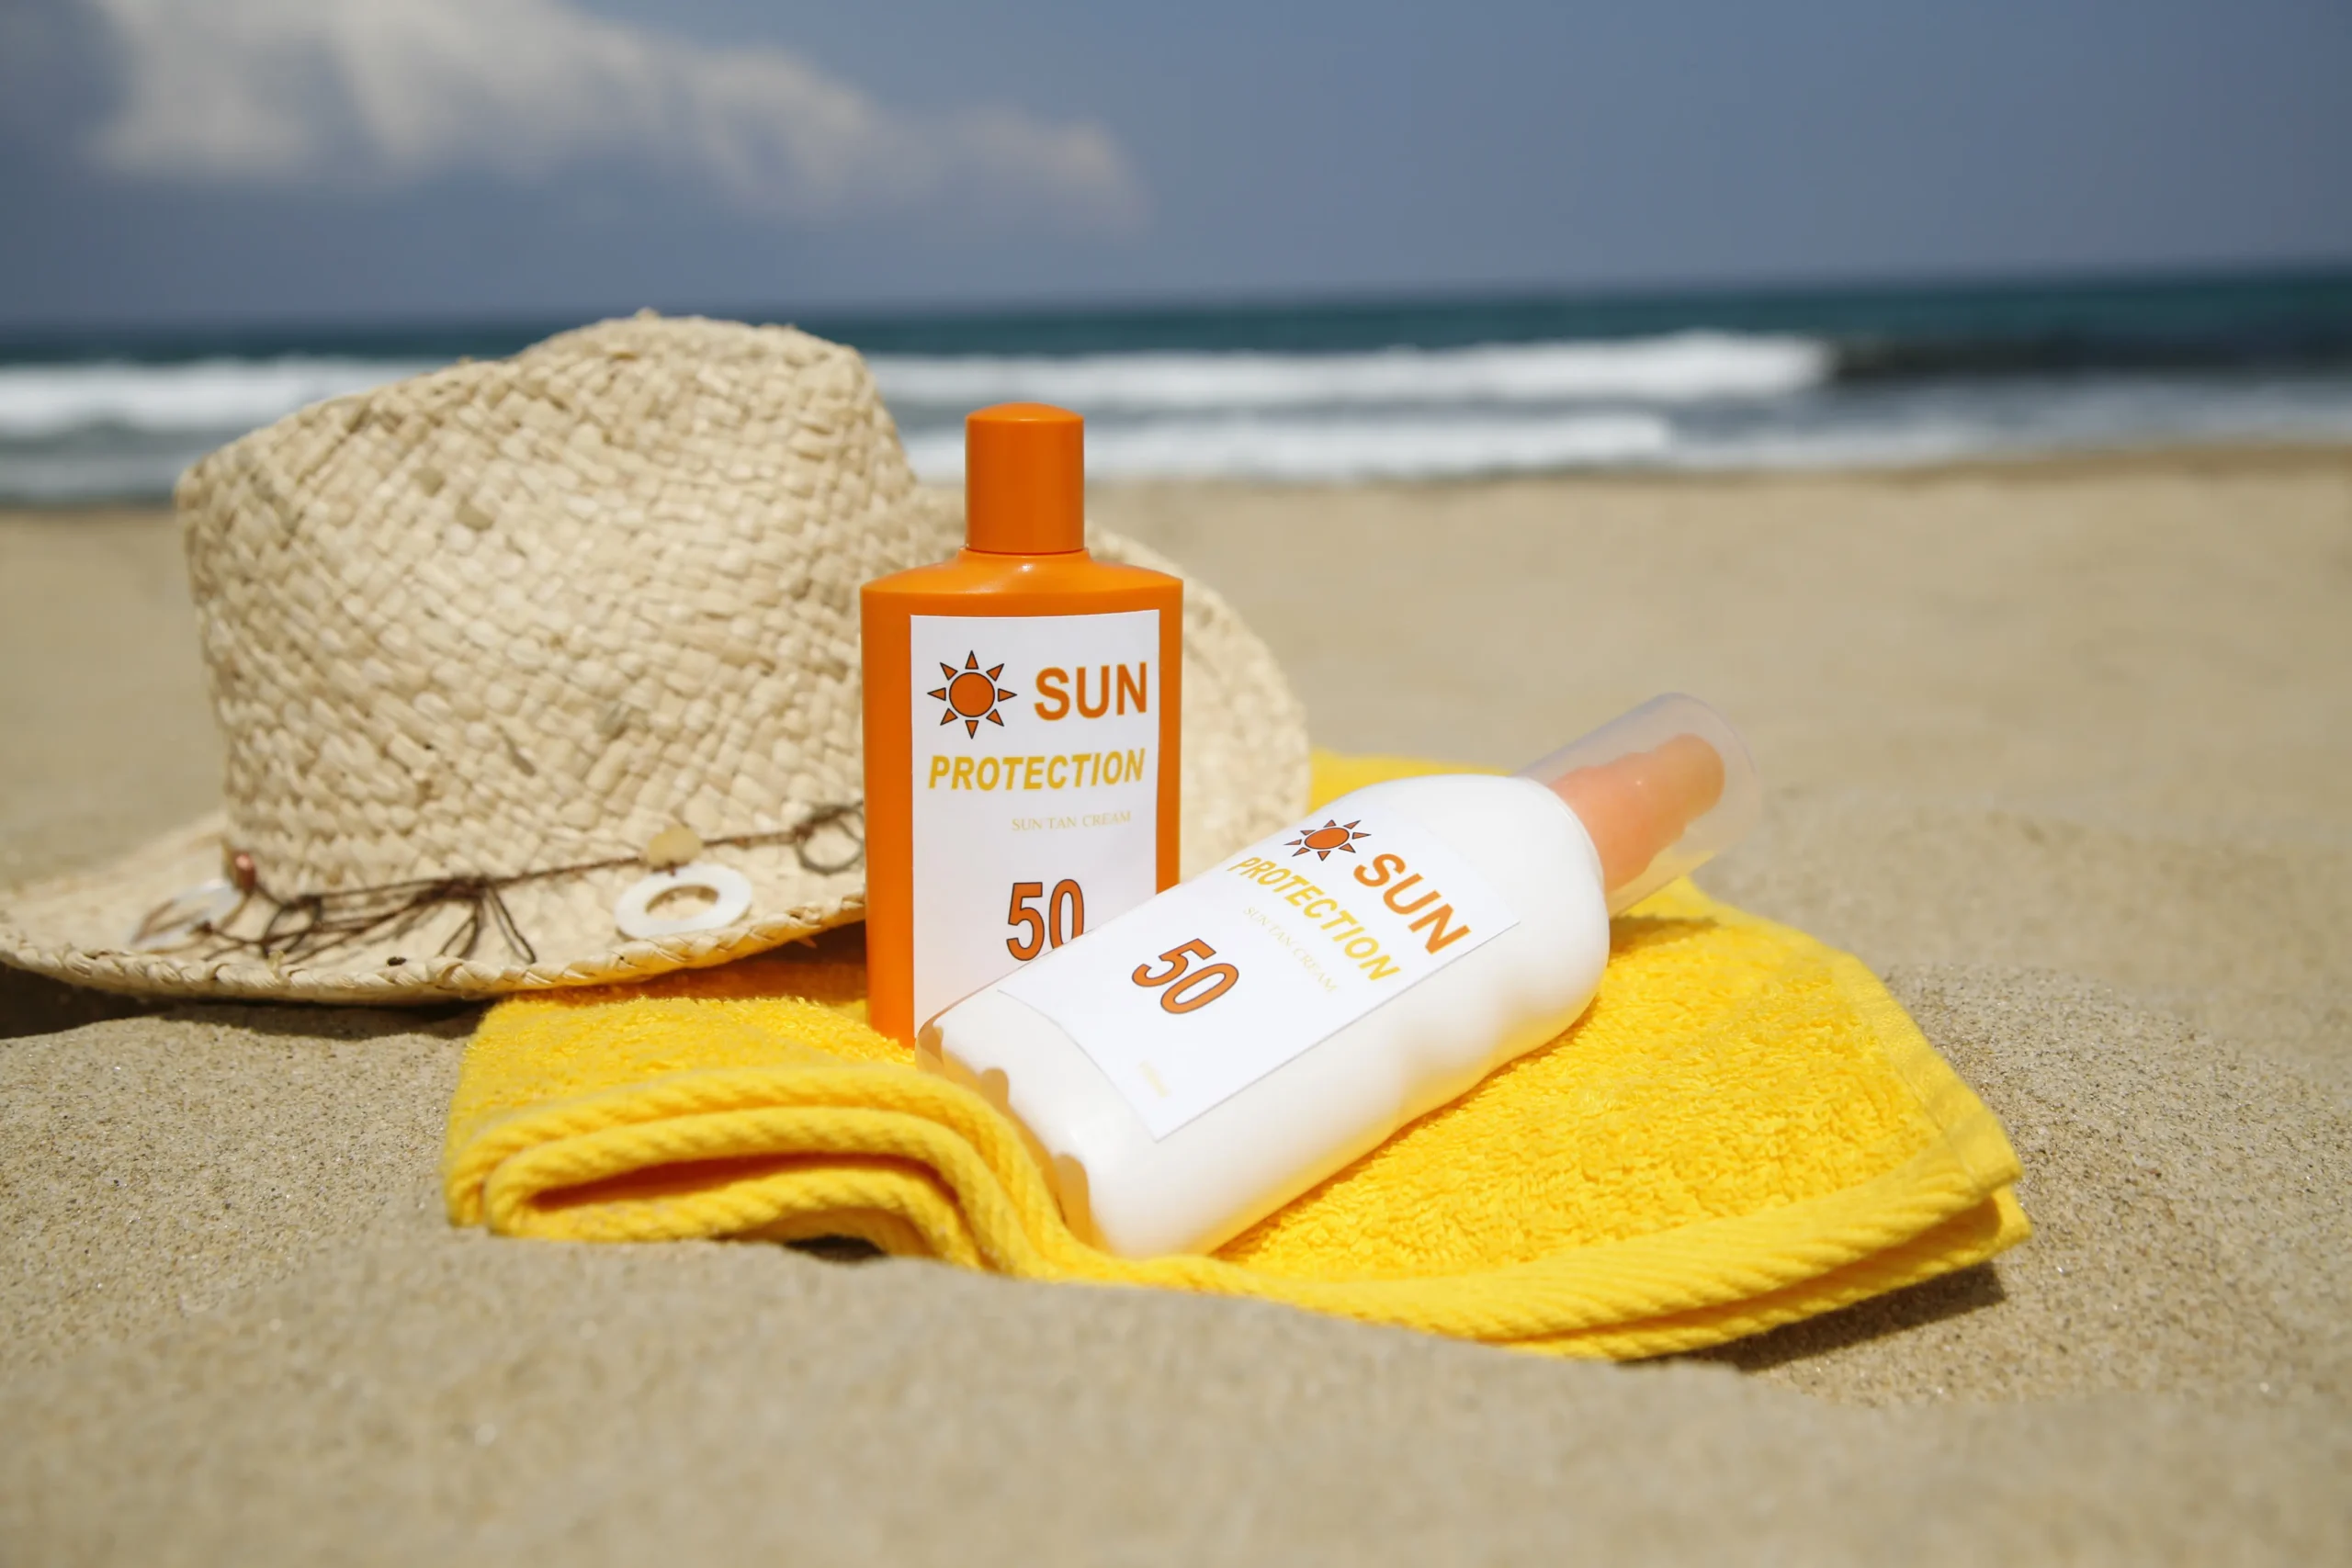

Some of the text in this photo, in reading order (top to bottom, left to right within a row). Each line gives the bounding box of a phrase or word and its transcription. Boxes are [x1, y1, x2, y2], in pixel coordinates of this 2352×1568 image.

[1034, 661, 1148, 721] SUN
[928, 748, 1146, 791] PROTECTION
[1012, 809, 1131, 831] SUN TAN CREAM
[1006, 879, 1084, 962] 50
[1227, 857, 1402, 982] PROTECTION
[1353, 853, 1472, 955] SUN
[1131, 938, 1239, 1015] 50
[1243, 907, 1338, 993] SUN TAN CREAM
